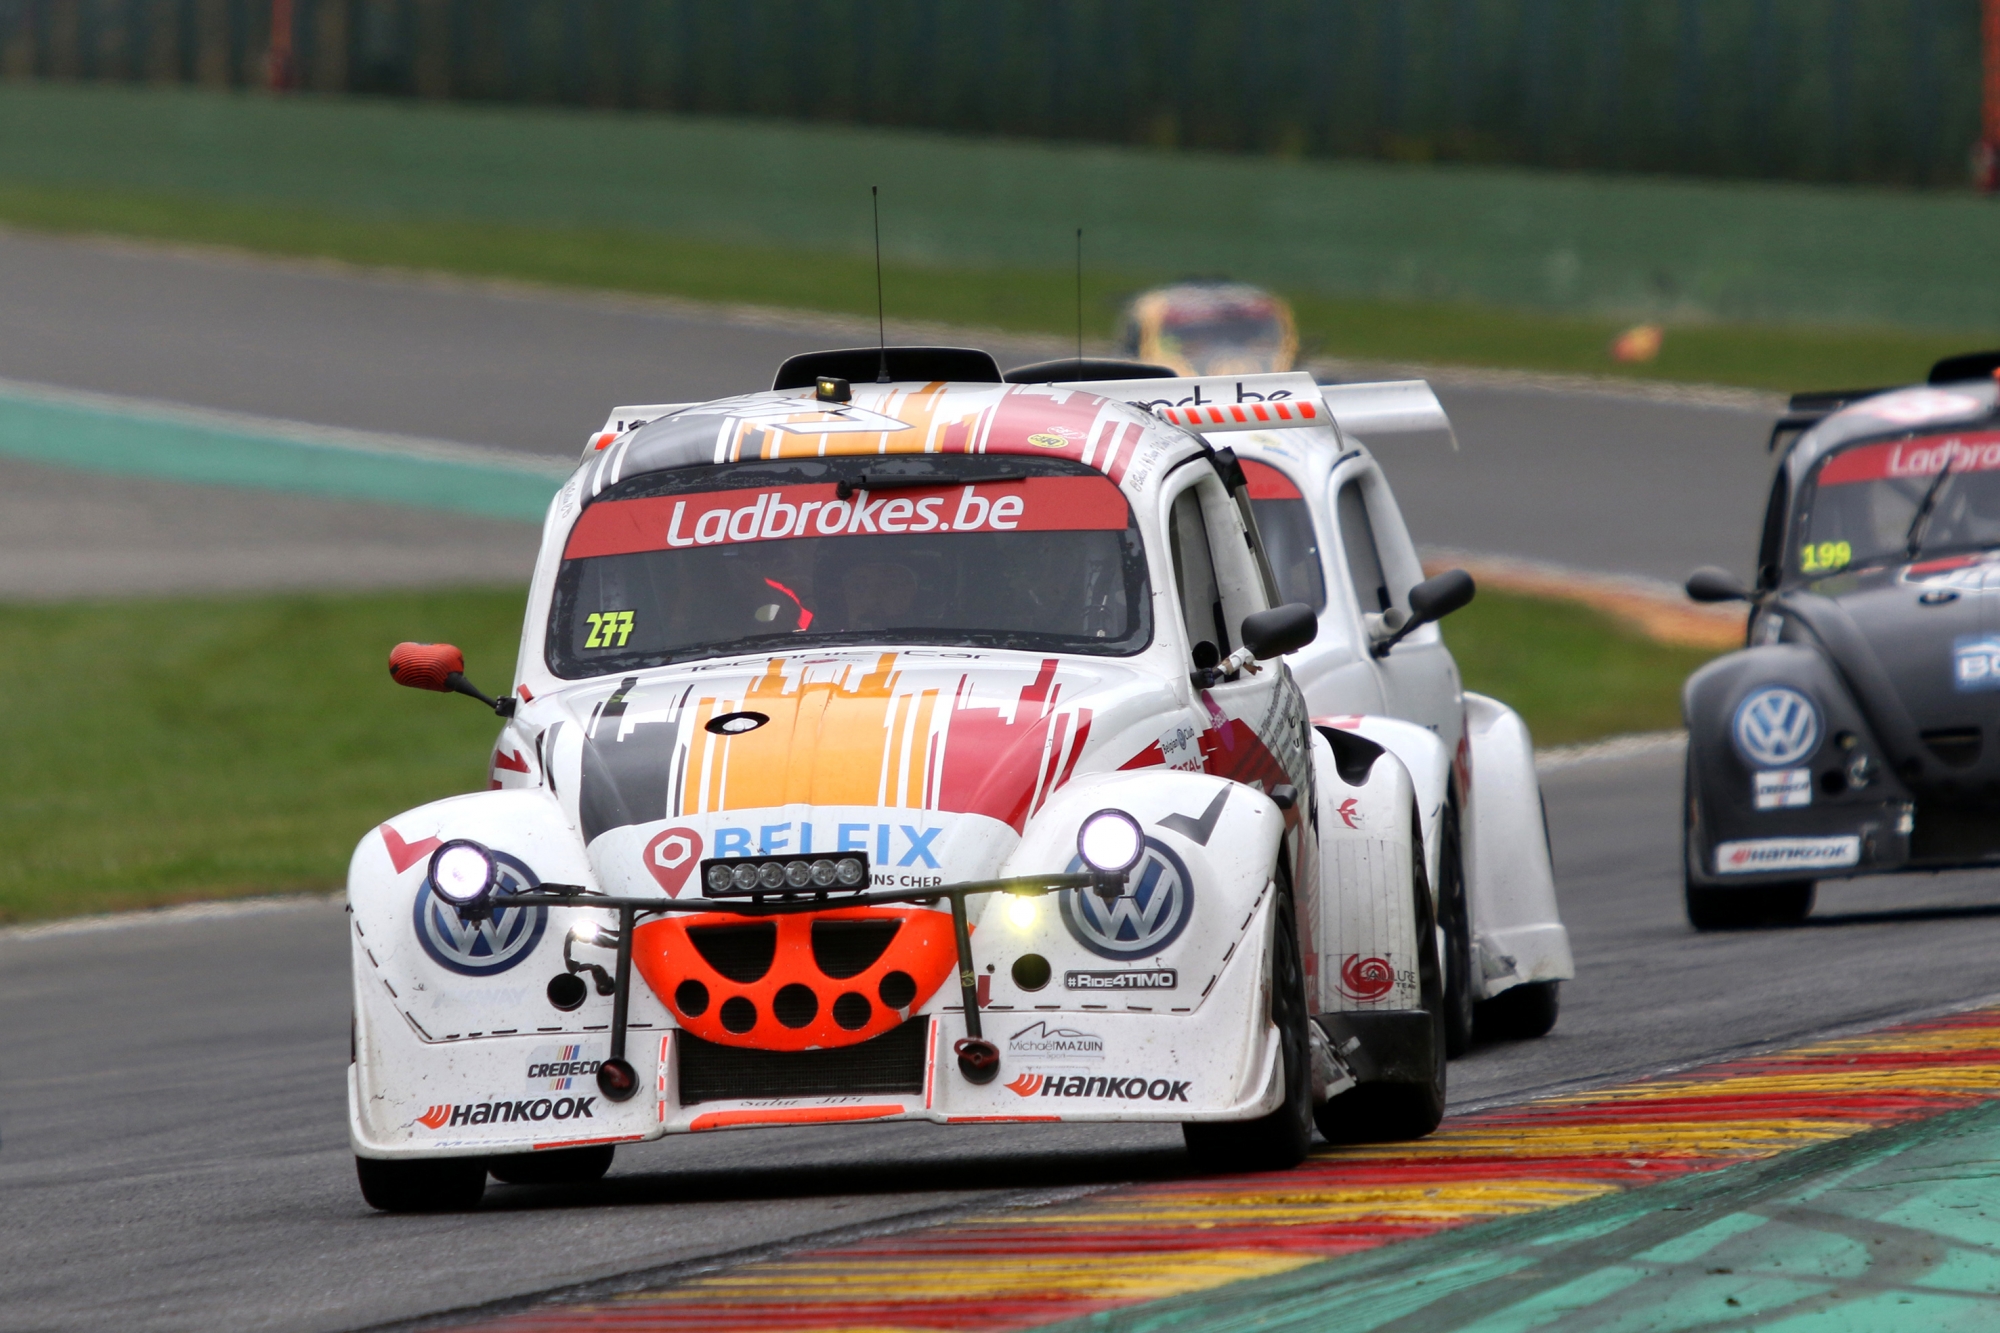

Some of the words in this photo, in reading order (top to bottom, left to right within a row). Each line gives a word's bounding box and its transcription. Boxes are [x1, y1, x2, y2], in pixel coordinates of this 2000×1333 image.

[666, 485, 1025, 547] Ladbrokes.be
[1802, 542, 1851, 571] 199
[584, 610, 635, 648] 277
[902, 875, 943, 888] CHER
[527, 1060, 601, 1078] CREDECO
